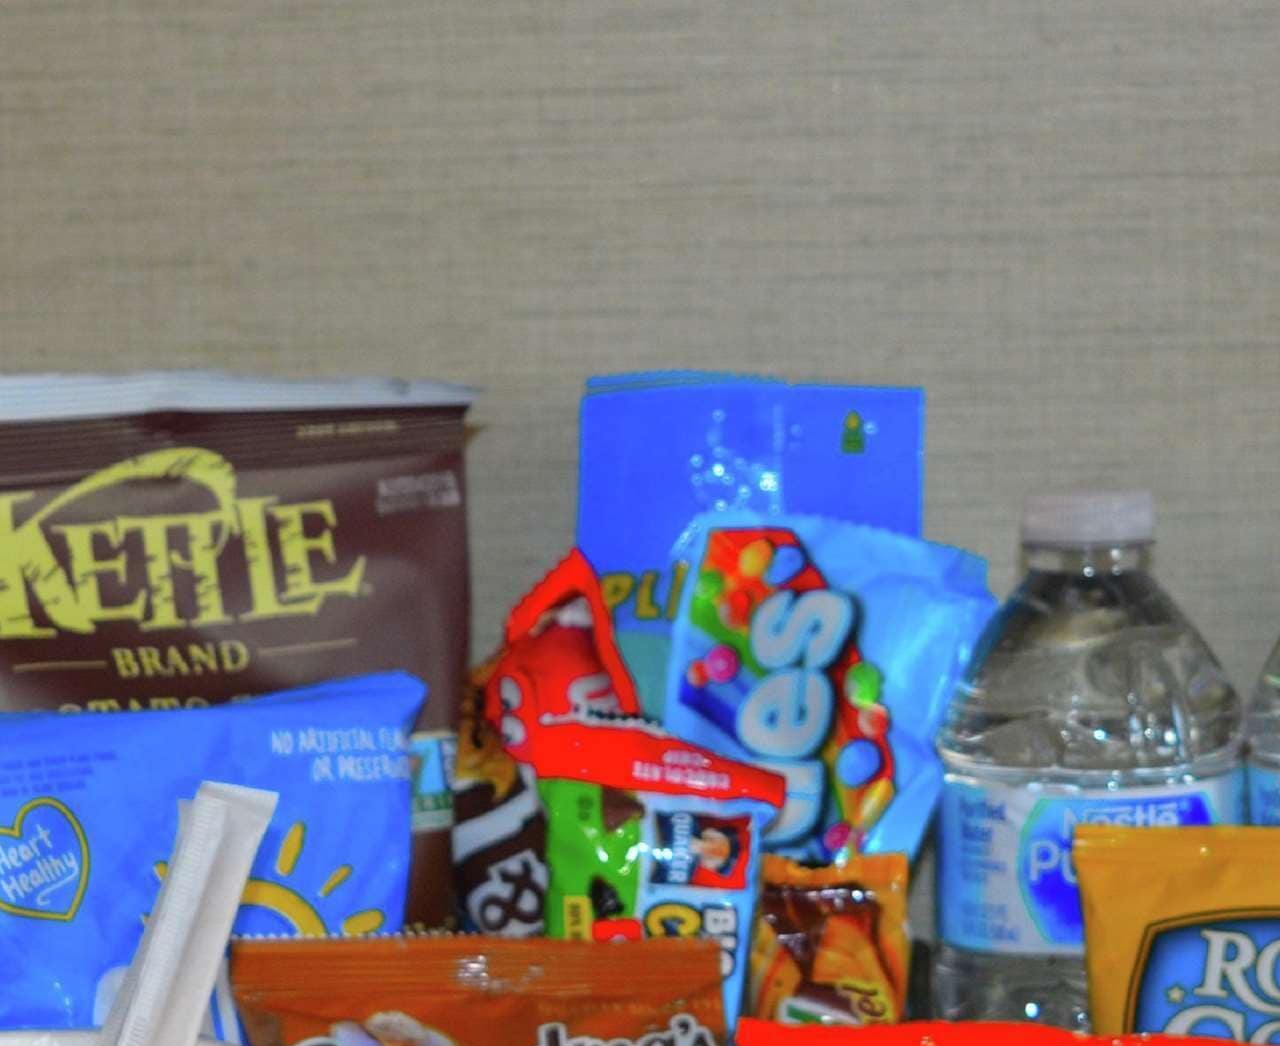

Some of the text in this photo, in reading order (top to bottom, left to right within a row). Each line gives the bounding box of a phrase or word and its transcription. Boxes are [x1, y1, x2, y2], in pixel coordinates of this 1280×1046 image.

[112, 640, 250, 678] BRAND
[670, 812, 694, 884] QUAKER
[0, 852, 79, 904] Healthy
